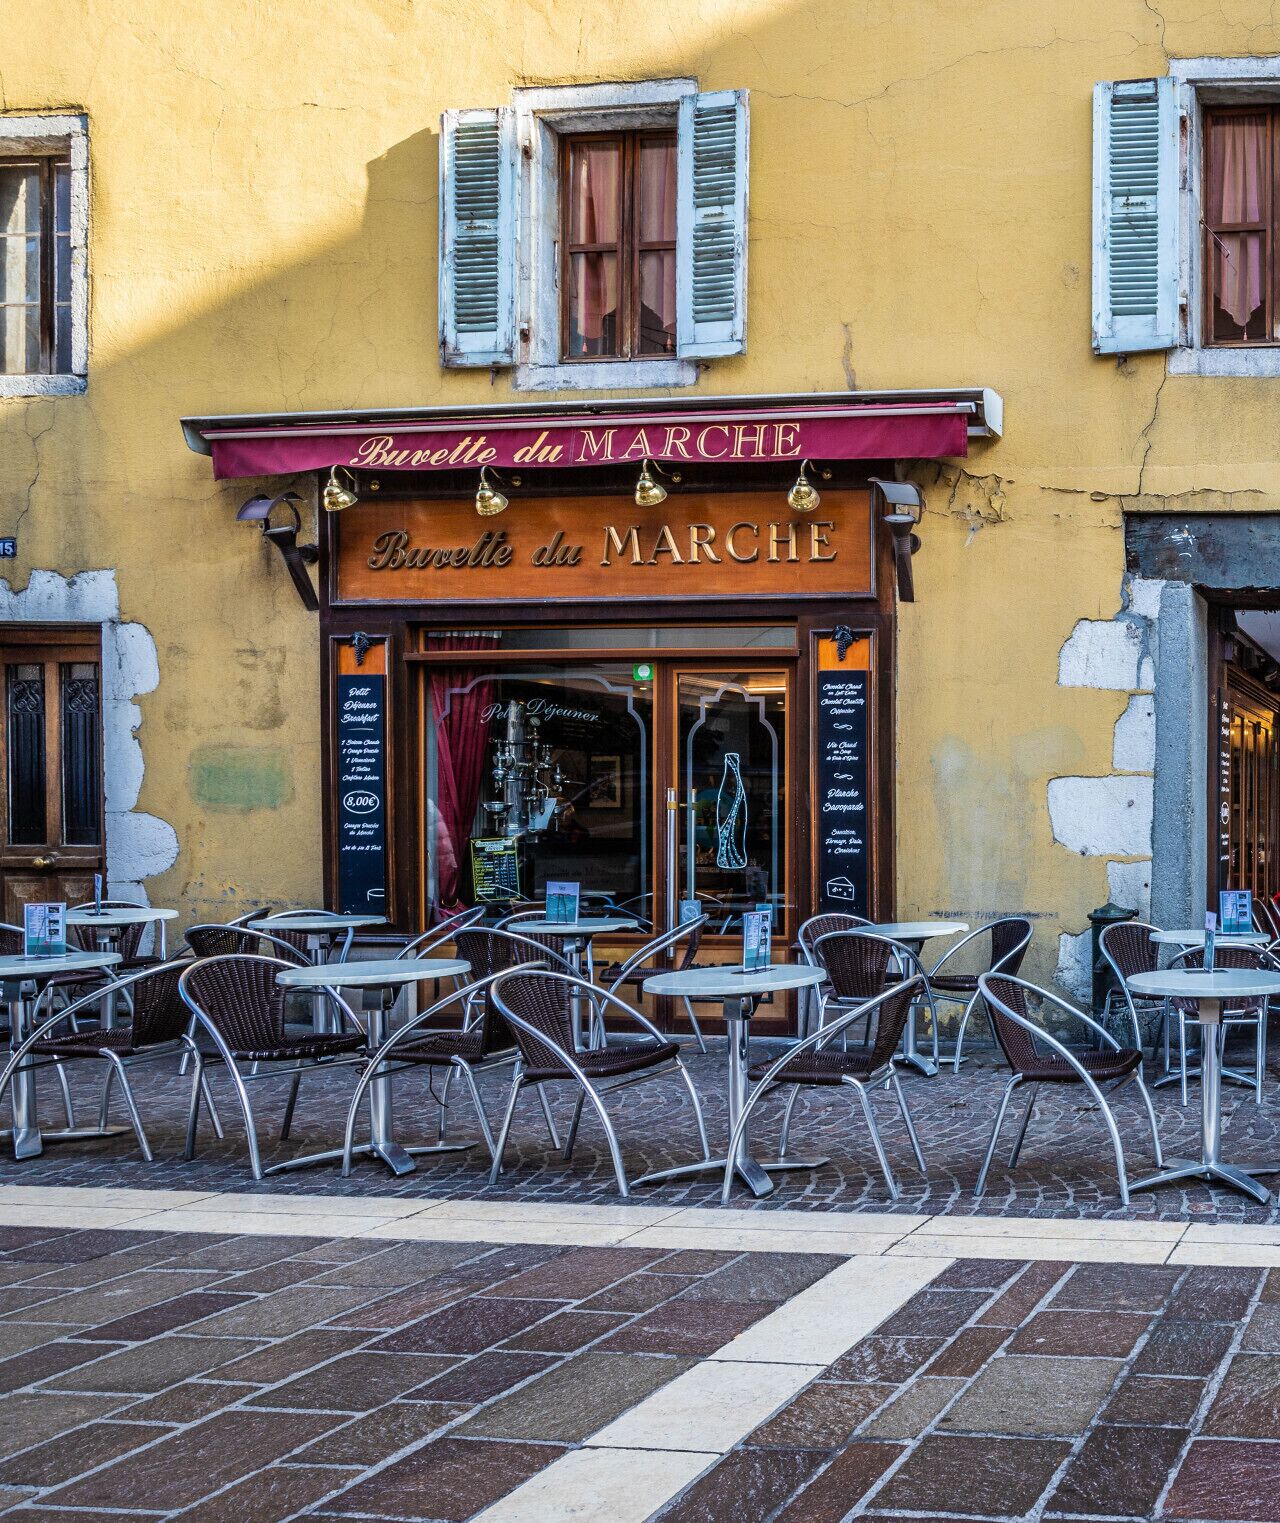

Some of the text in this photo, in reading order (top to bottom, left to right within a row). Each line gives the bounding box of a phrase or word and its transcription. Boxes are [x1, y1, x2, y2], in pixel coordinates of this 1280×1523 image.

[350, 424, 802, 466] Buvette du MARCHE
[367, 522, 838, 570] Buvette du MARCHE
[341, 714, 379, 724] Breakfast
[526, 698, 598, 721] Déjeuner
[347, 797, 375, 807] 8,00€
